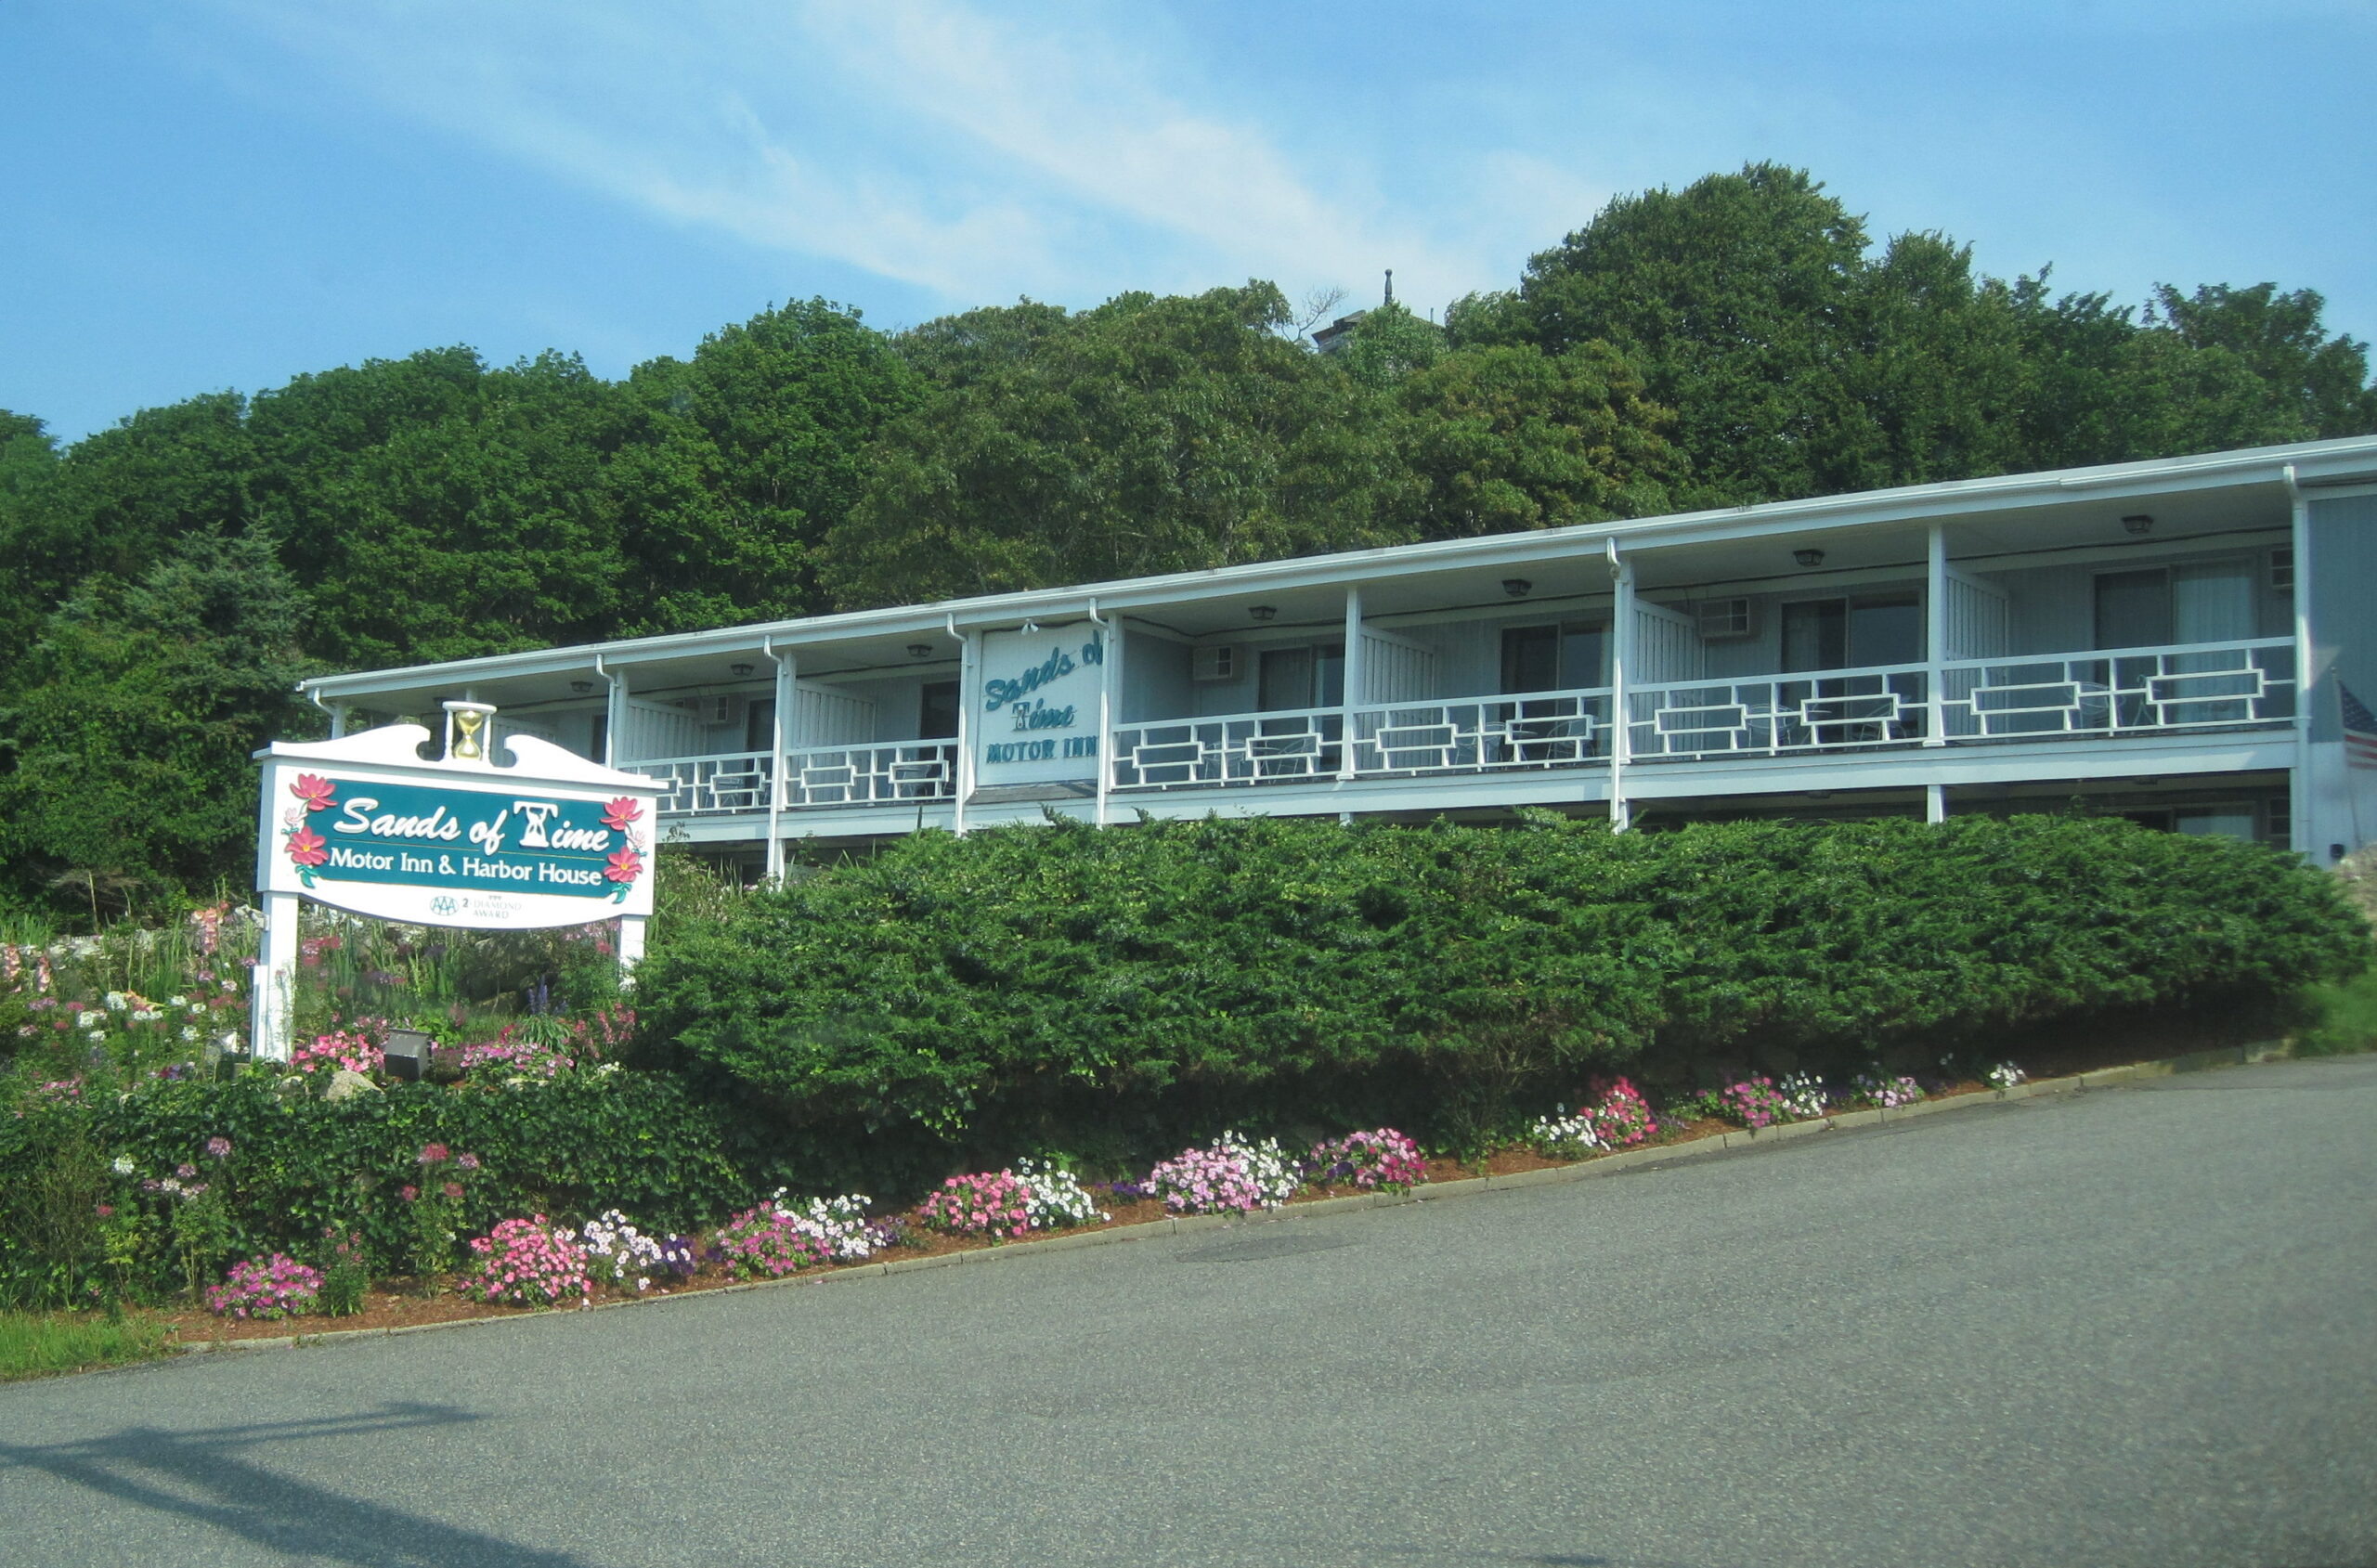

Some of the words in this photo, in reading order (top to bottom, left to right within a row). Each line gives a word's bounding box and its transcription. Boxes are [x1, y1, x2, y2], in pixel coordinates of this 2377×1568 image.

[985, 647, 1074, 711] Sands
[1012, 698, 1074, 731] Time
[986, 739, 1056, 763] MOTOR
[1064, 735, 1097, 758] INN
[333, 797, 461, 839] Sands
[469, 810, 508, 855] of
[513, 801, 610, 853] Time
[330, 847, 394, 871] Motor
[400, 852, 434, 874] Inn
[438, 855, 456, 875] &
[462, 857, 532, 881] Harbor
[538, 862, 603, 886] House
[432, 896, 457, 916] AAA
[473, 910, 510, 919] AWARD
